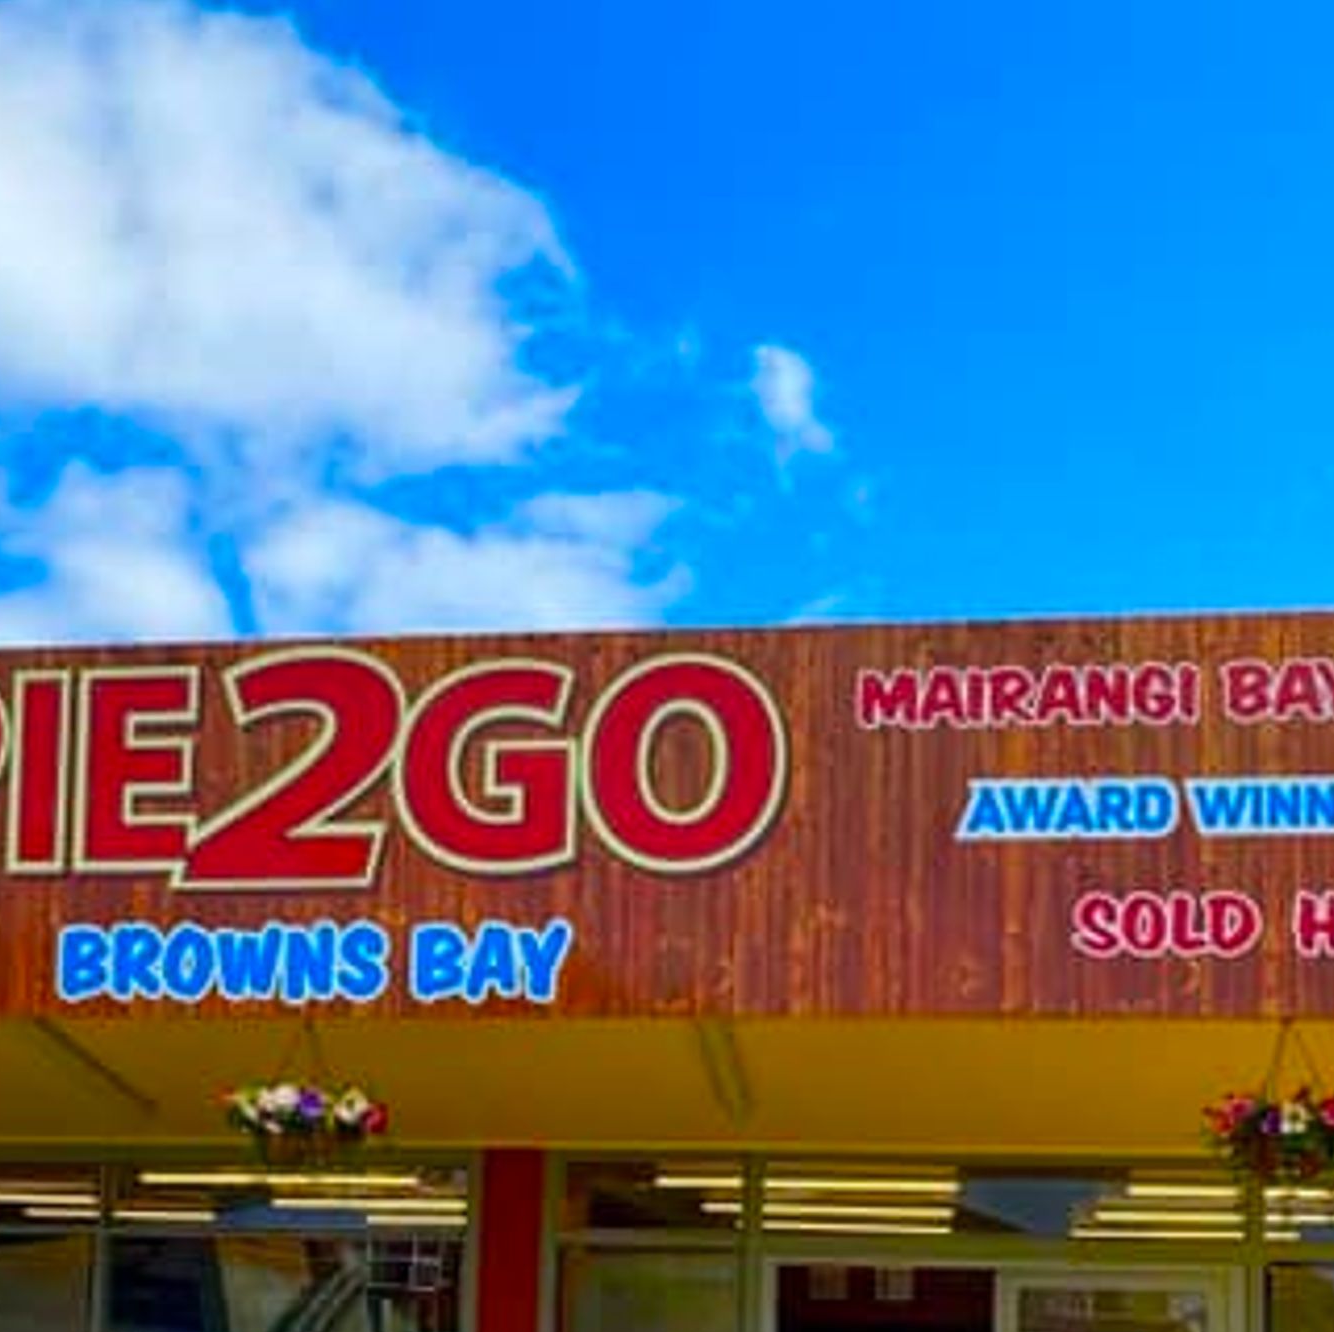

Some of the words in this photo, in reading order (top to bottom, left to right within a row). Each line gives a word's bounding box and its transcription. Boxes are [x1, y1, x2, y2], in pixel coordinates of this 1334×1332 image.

[857, 660, 1200, 728] MAIRANGI
[956, 777, 1176, 841] AWARD
[1072, 890, 1261, 957] SOLD
[56, 920, 387, 1005] BROWNS
[409, 917, 571, 1005] BAY
